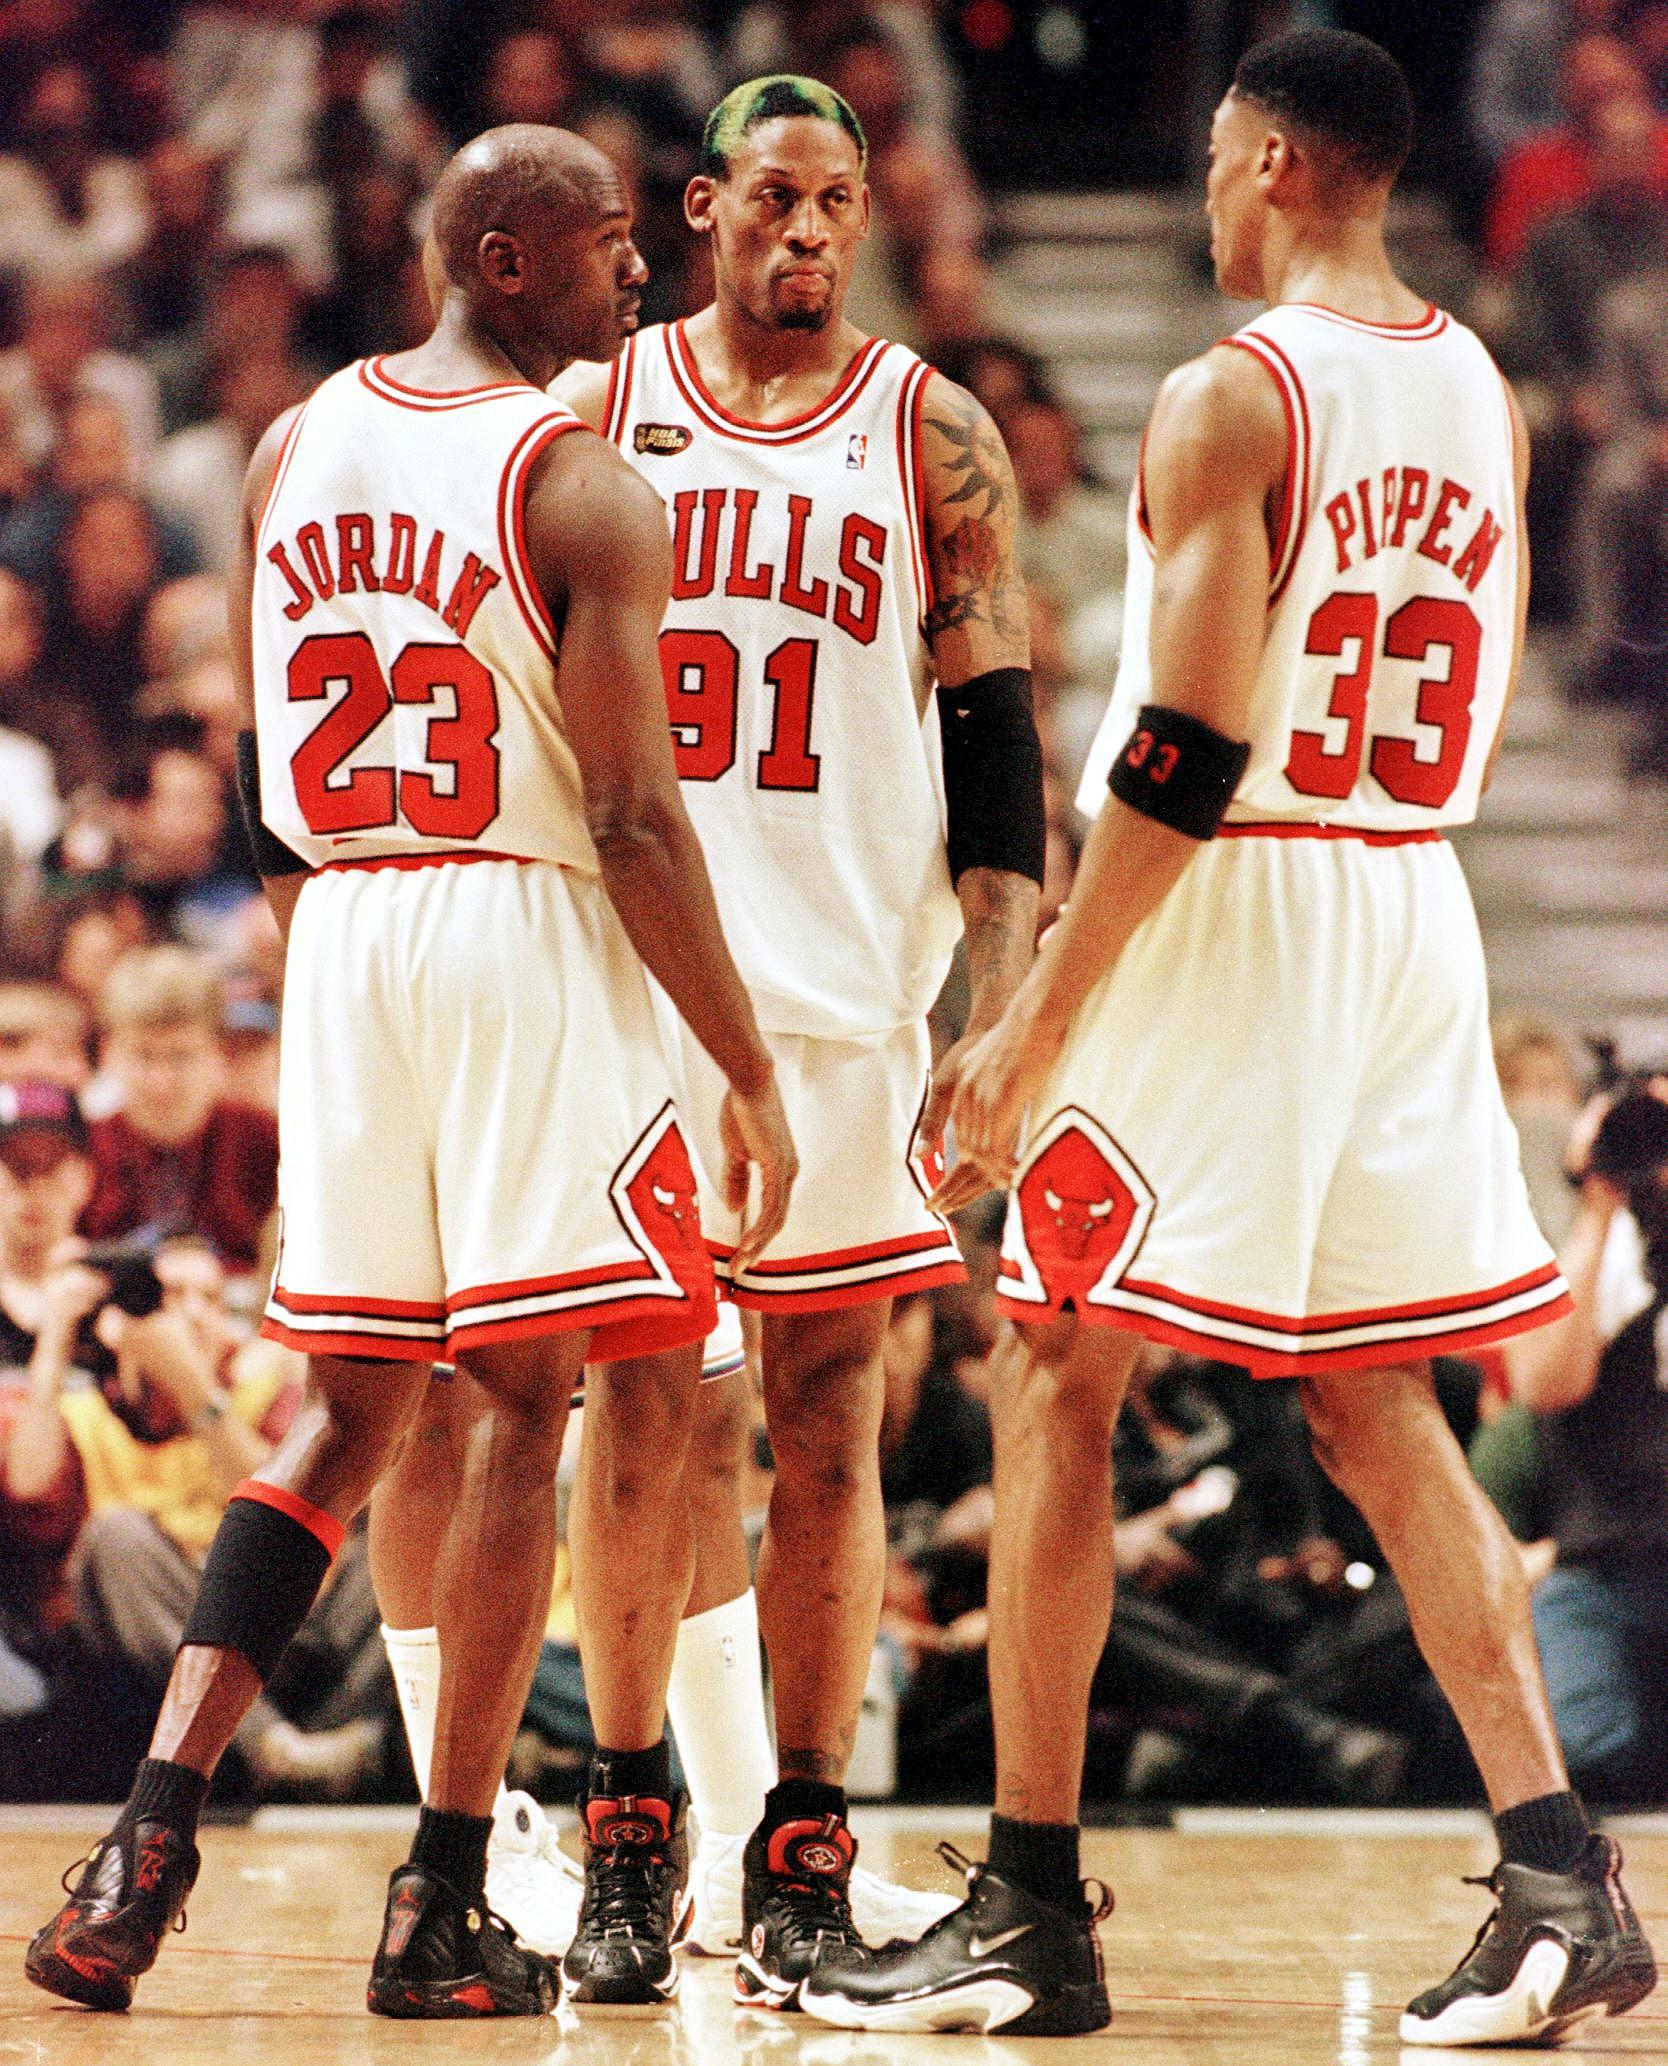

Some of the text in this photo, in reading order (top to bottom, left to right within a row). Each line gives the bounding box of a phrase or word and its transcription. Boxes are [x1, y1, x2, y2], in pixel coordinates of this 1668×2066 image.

[266, 512, 501, 639] JORDAN
[671, 488, 887, 646] ULLS
[1324, 466, 1504, 593] PIPPEN
[287, 631, 500, 840] 23
[658, 628, 821, 793] 91
[1126, 730, 1181, 784] 33
[1283, 591, 1482, 809] 33
